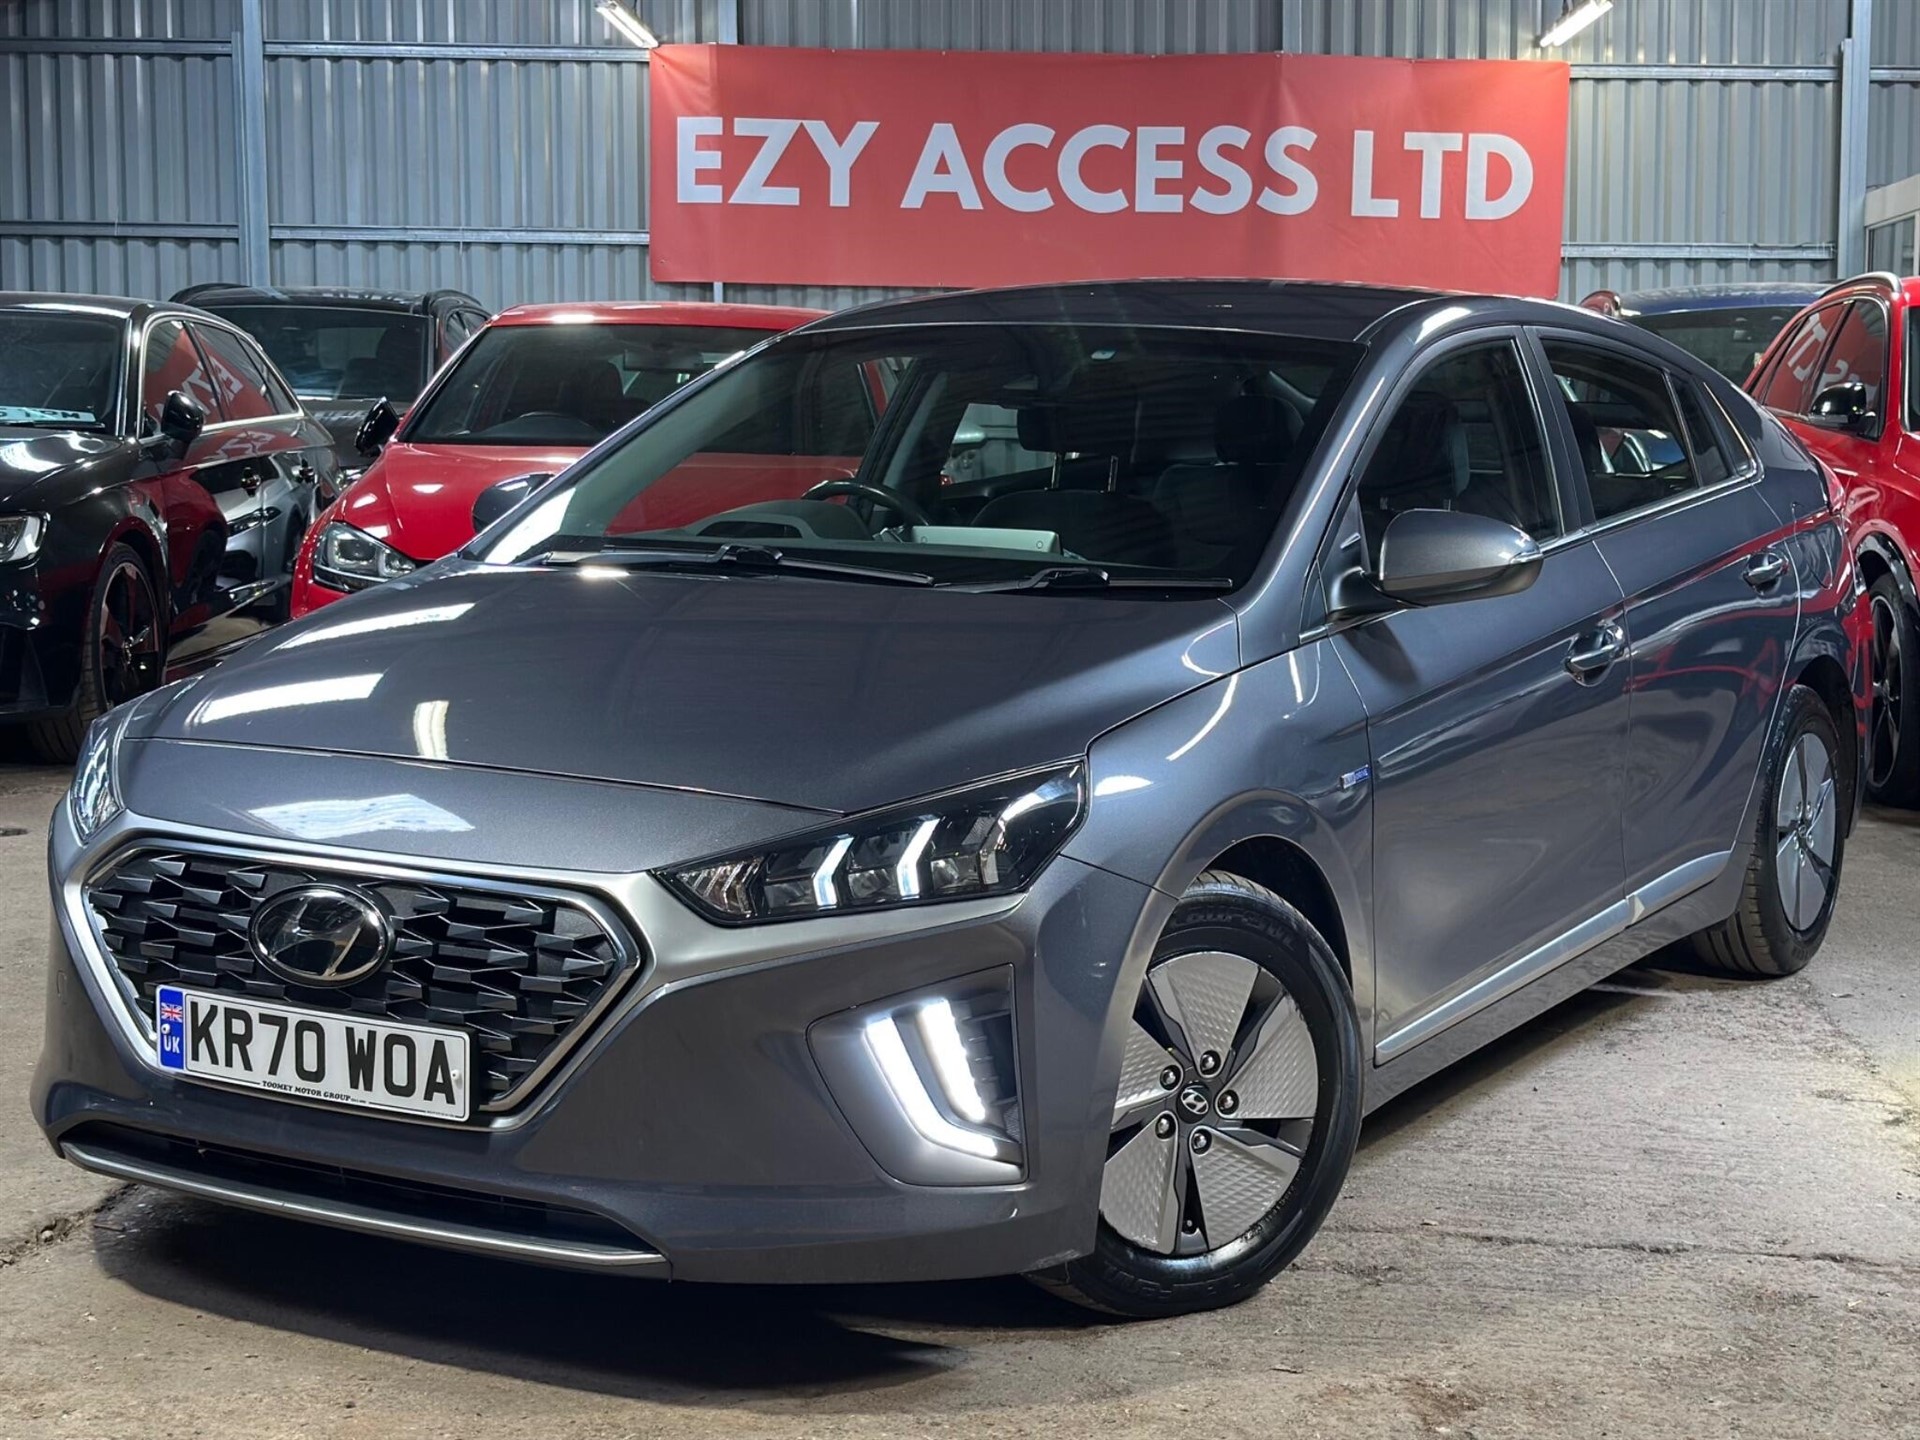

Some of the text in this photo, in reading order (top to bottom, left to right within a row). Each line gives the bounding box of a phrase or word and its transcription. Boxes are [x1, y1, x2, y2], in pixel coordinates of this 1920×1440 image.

[676, 115, 1534, 221] EZY ACCESS LTD
[163, 1034, 180, 1053] UK
[190, 1001, 456, 1105] KR70 WOA
[262, 1080, 293, 1092] TOOMEY
[295, 1086, 322, 1097] MOTOR
[323, 1090, 351, 1102] GROUP
